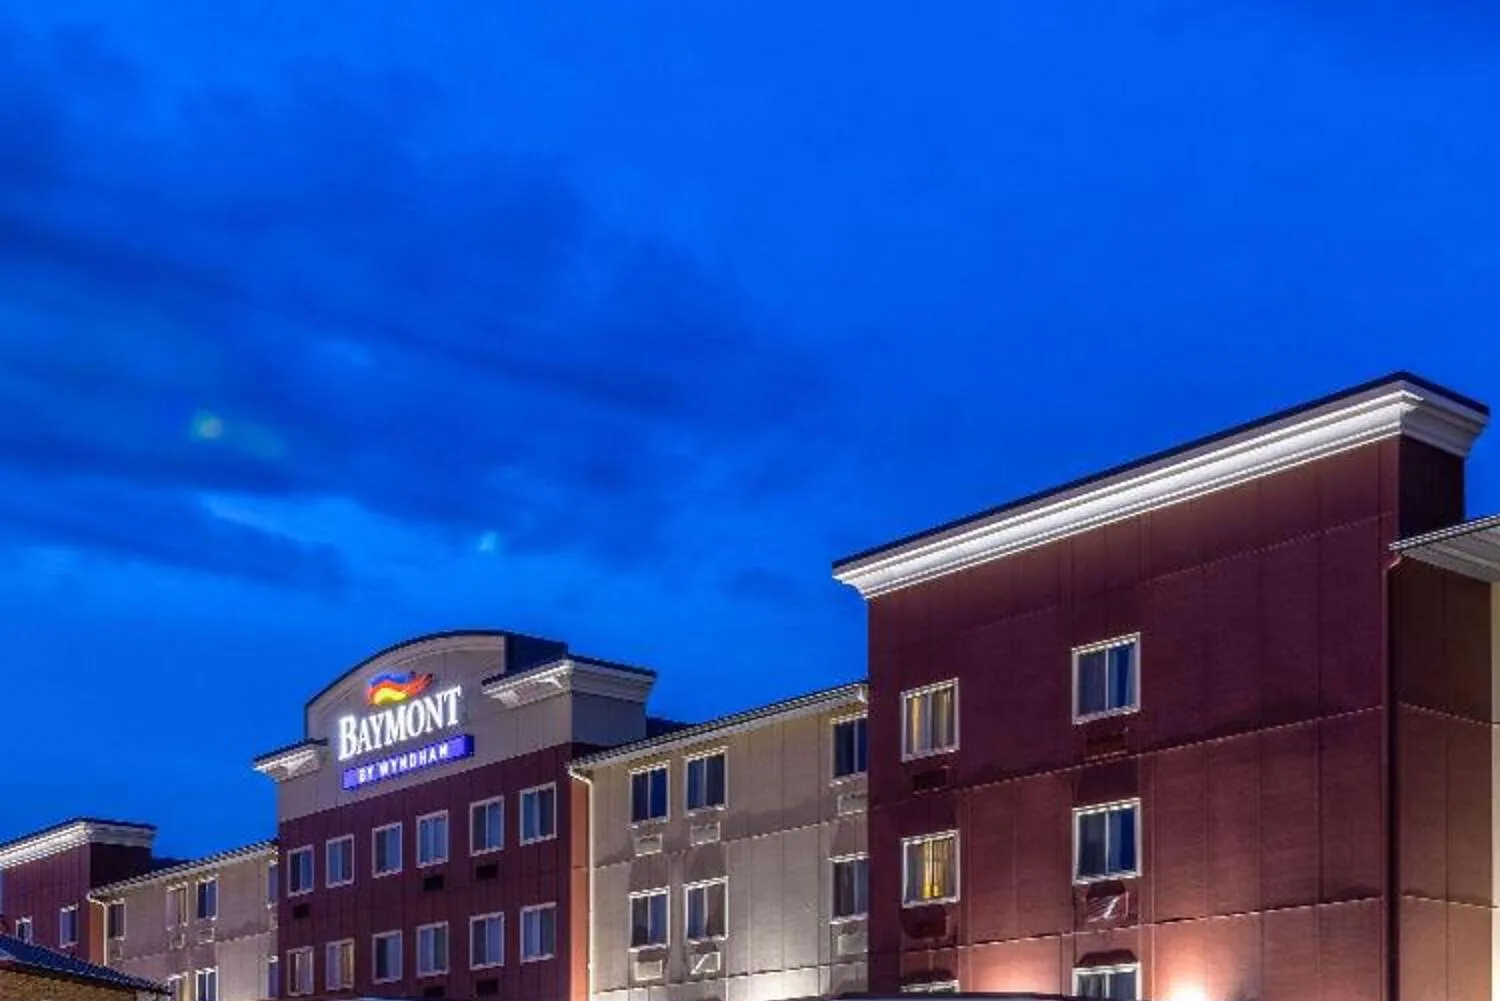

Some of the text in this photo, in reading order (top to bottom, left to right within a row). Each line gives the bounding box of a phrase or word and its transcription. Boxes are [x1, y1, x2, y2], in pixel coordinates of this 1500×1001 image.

[338, 685, 461, 761] BAYMONT
[357, 743, 449, 783] BY WYNDHAM
